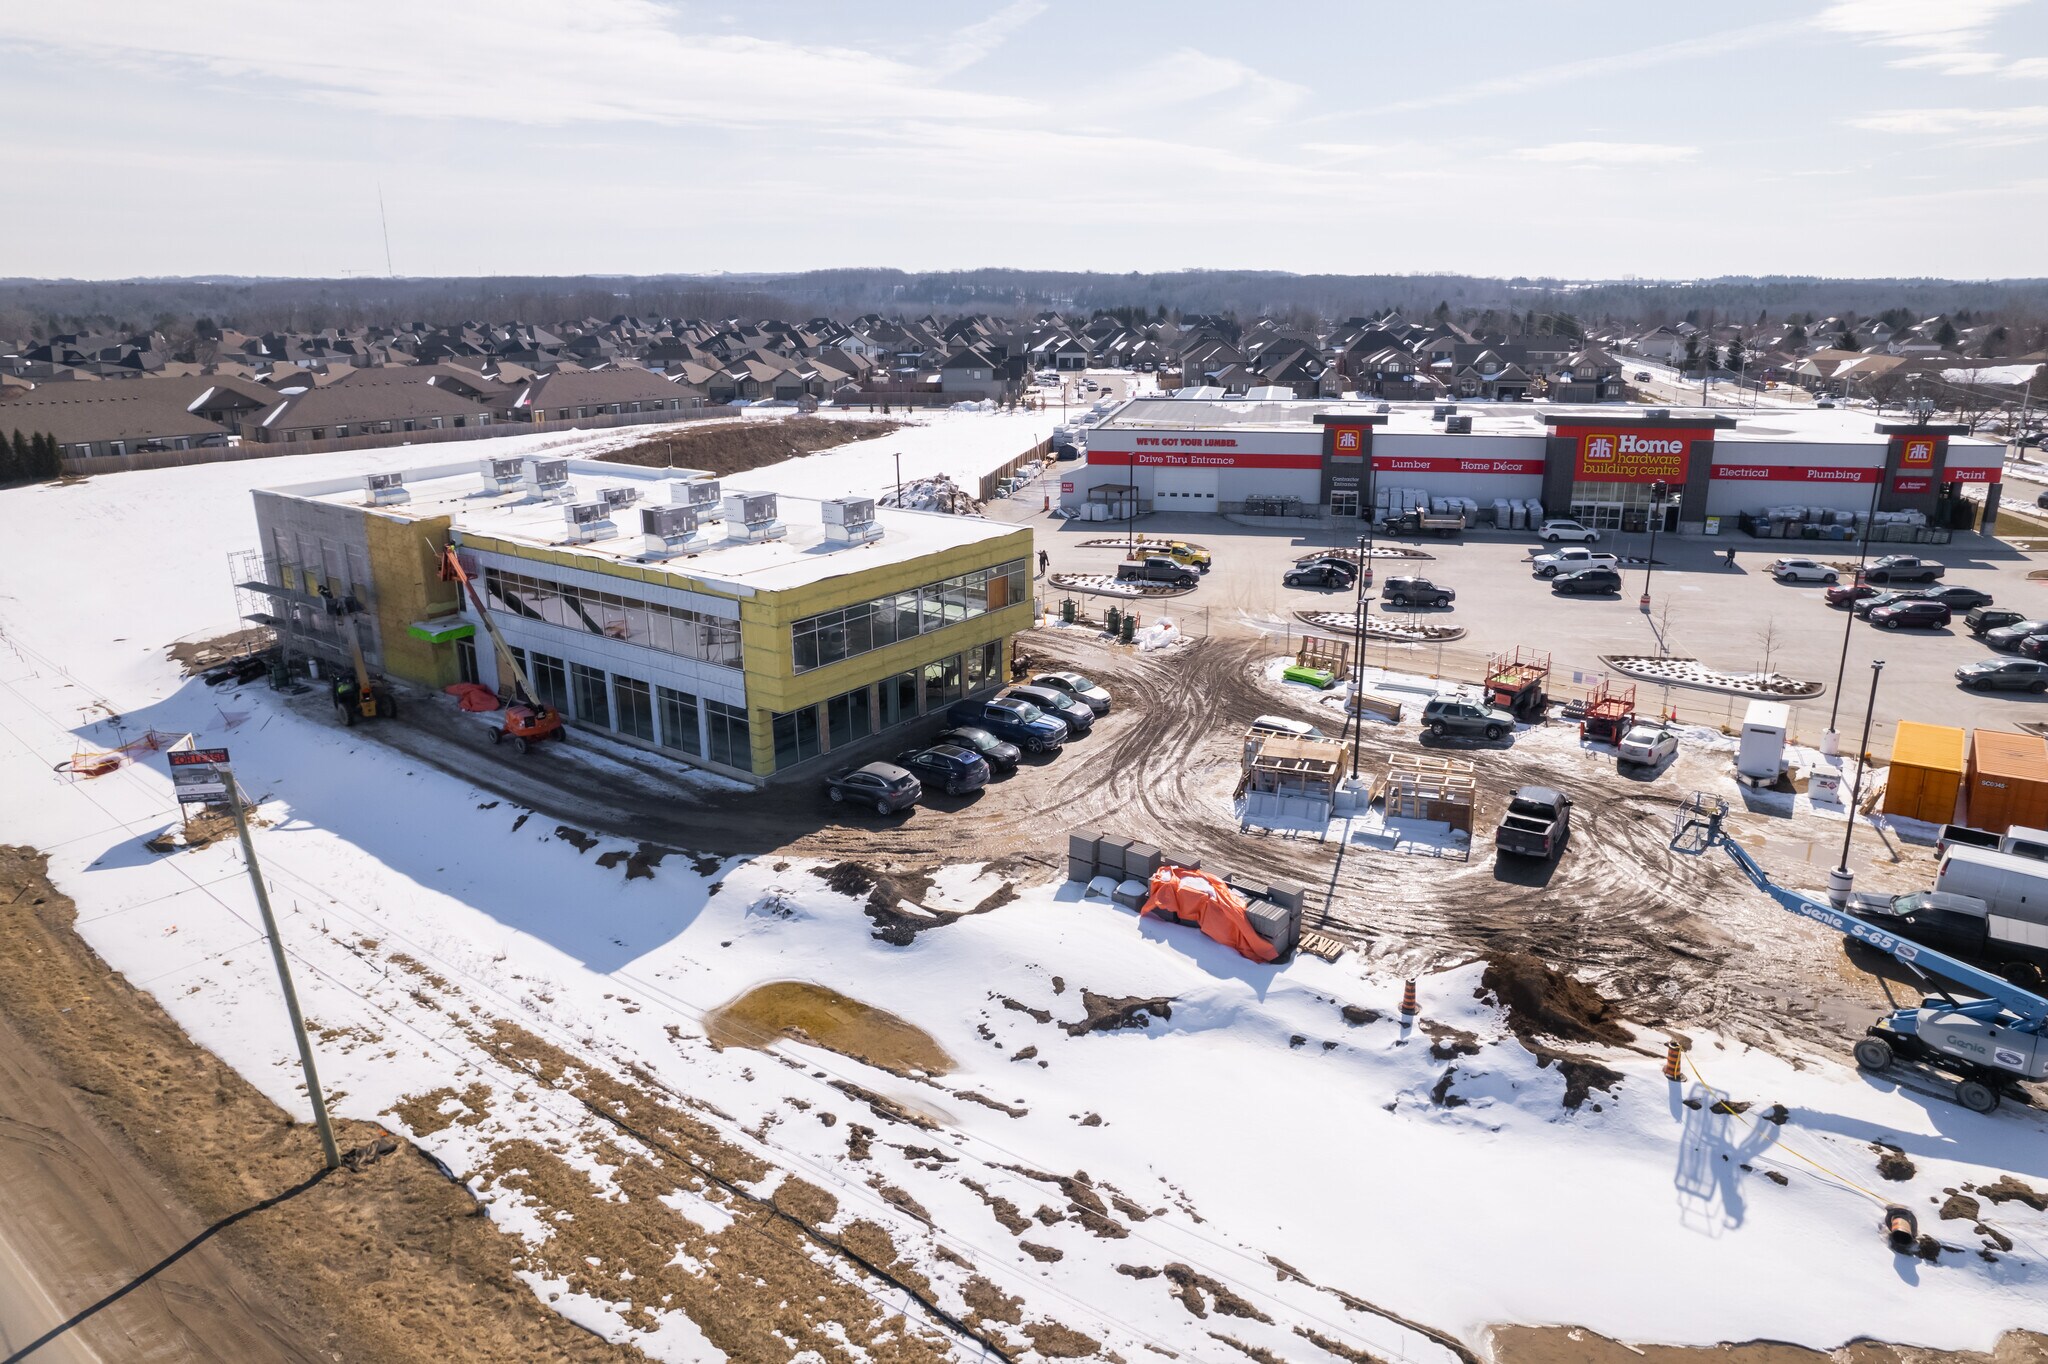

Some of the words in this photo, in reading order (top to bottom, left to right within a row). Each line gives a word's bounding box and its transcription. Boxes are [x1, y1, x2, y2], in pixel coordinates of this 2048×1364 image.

[1136, 437, 1160, 446] WE'VE
[1162, 438, 1178, 446] GOT
[1180, 438, 1203, 447] YOUR
[1204, 438, 1238, 447] LUMBER.
[1618, 434, 1683, 454] Home
[1139, 454, 1164, 463] Drive
[1166, 455, 1188, 464] Thru
[1190, 455, 1235, 465] Entrance
[1391, 459, 1431, 469] Lumber
[1617, 452, 1681, 465] hardware
[1460, 461, 1490, 470] Home
[1493, 461, 1523, 471] Décor
[1582, 463, 1638, 478] building
[1639, 465, 1681, 476] centre
[1719, 467, 1769, 477] Electrical
[1806, 469, 1862, 482] Plumbing
[1955, 470, 1986, 480] Paint
[1800, 902, 1844, 928] Genie
[1850, 924, 1896, 949] S-65
[1946, 1035, 1987, 1055] Genie
